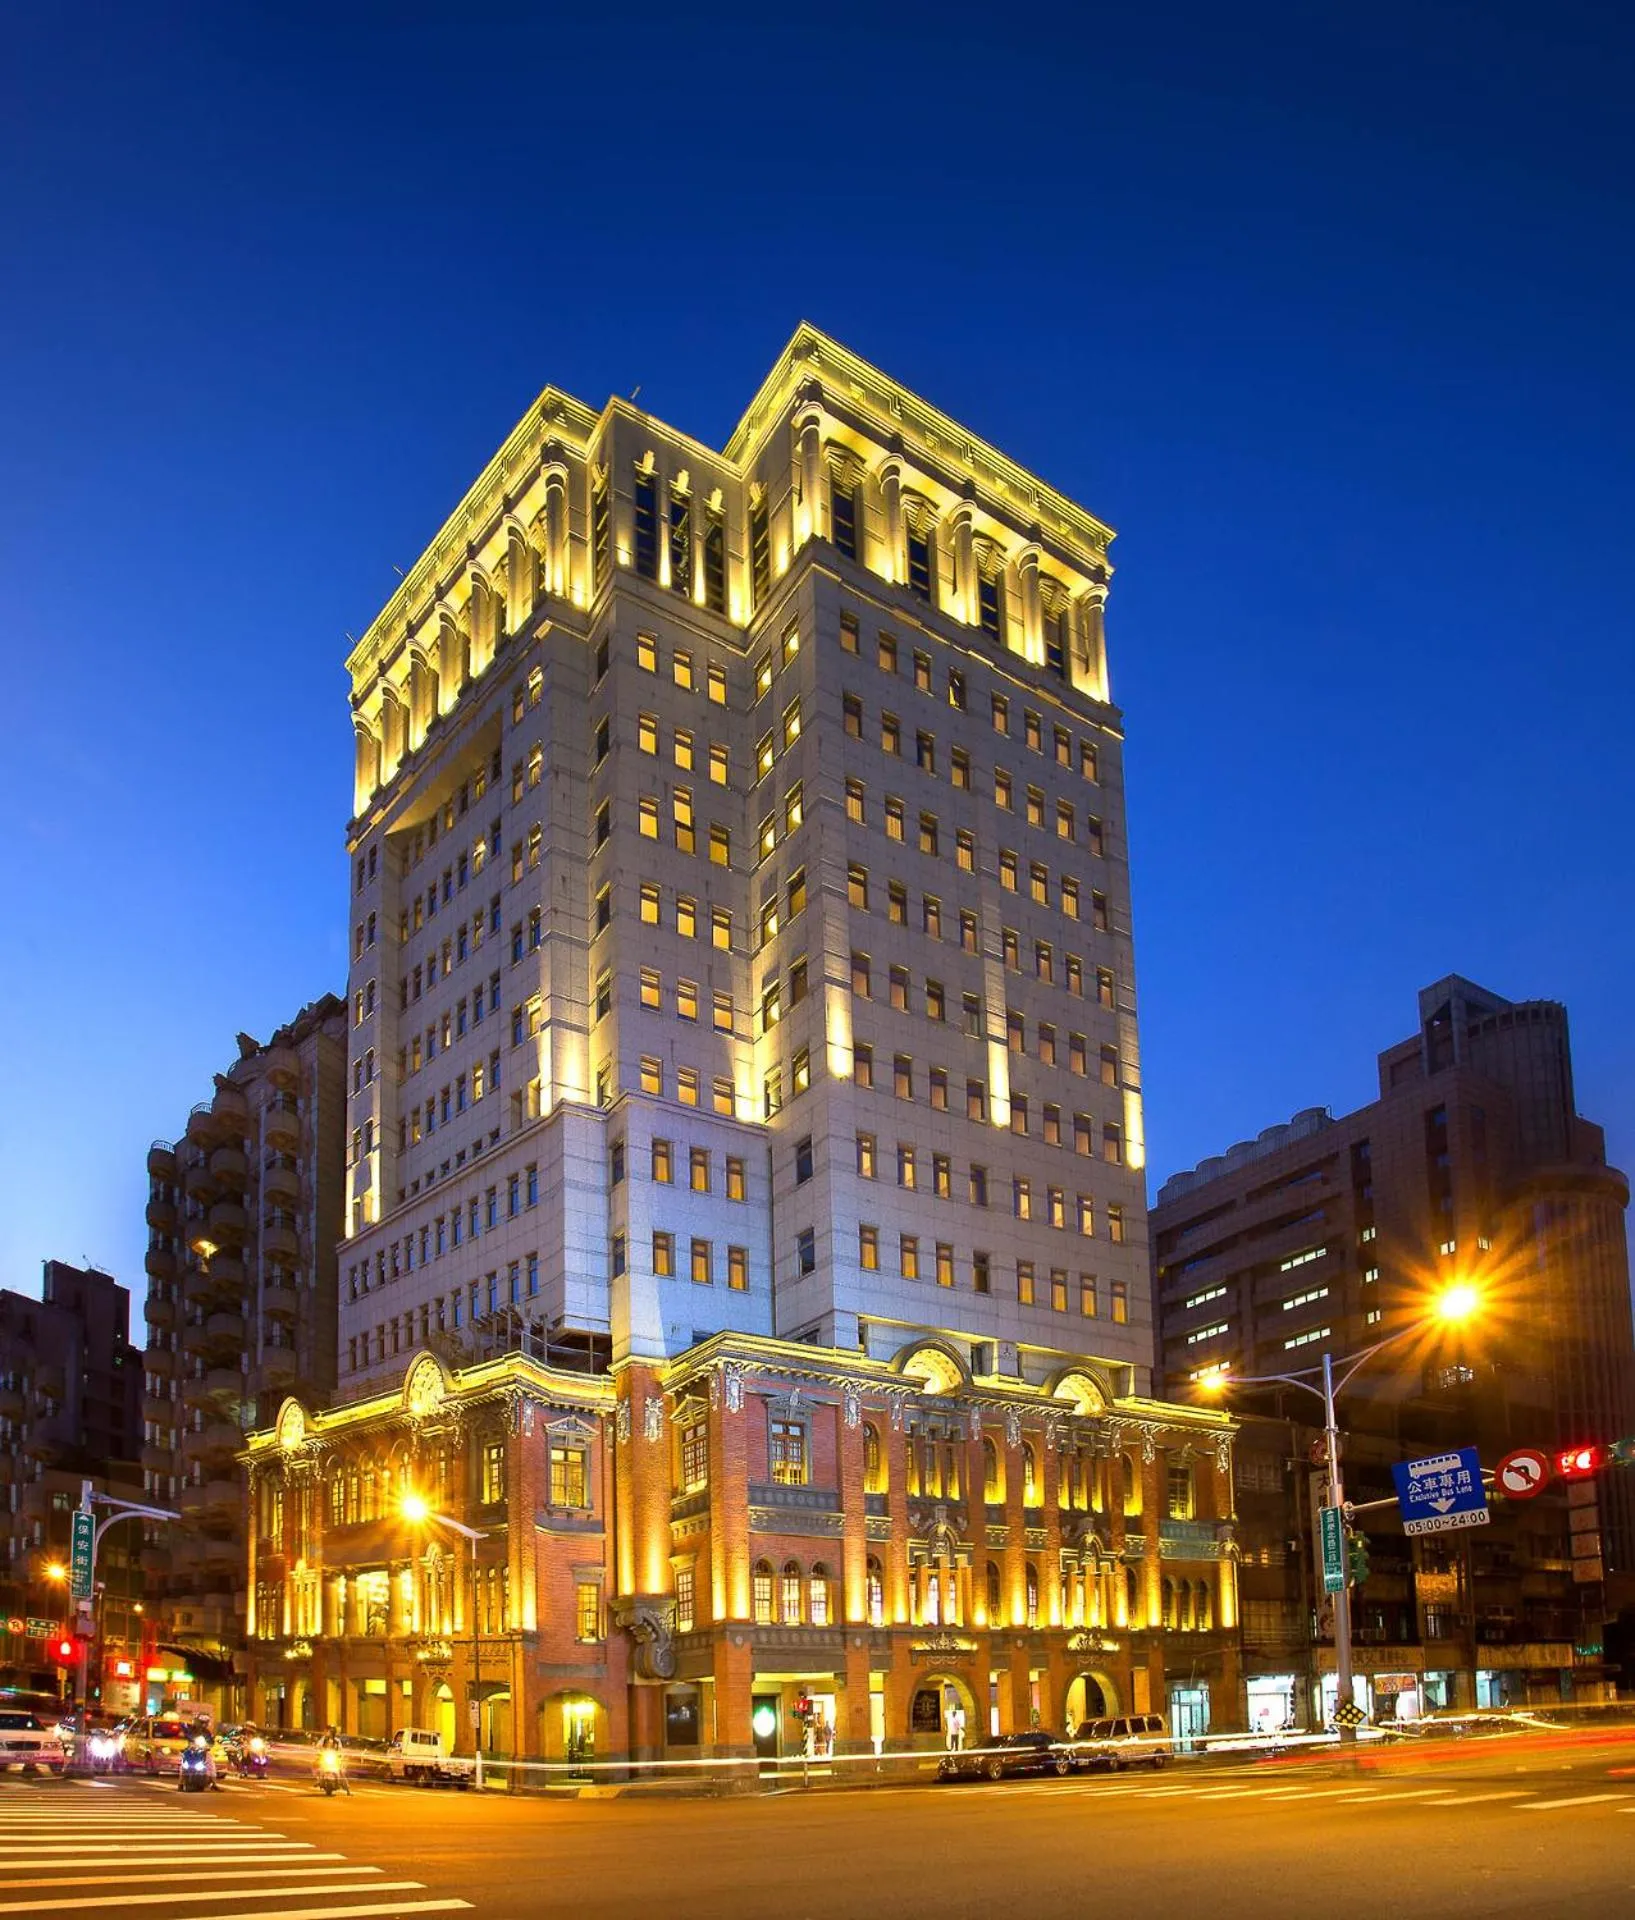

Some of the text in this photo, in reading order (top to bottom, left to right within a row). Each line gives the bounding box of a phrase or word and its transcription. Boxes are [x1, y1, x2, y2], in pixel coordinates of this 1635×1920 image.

[1408, 1470, 1470, 1494] 公車專用
[1408, 1511, 1486, 1533] 05:00~24:00
